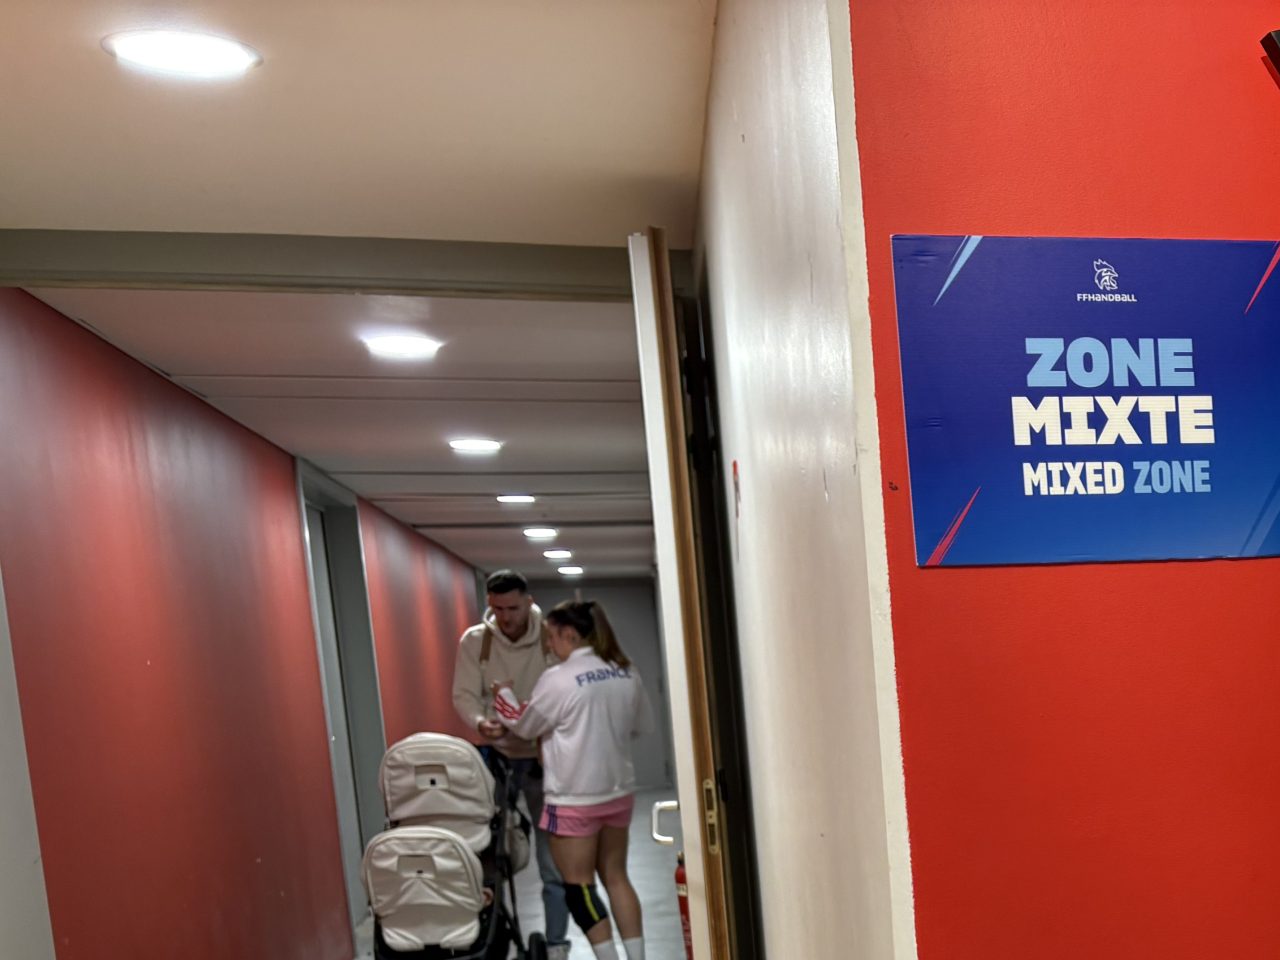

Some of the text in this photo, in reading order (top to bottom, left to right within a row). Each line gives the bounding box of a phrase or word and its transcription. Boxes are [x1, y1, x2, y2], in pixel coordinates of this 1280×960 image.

[1025, 336, 1195, 388] ZONE
[1011, 395, 1215, 446] MIXTE
[1022, 460, 1211, 496] MIXED ZONE
